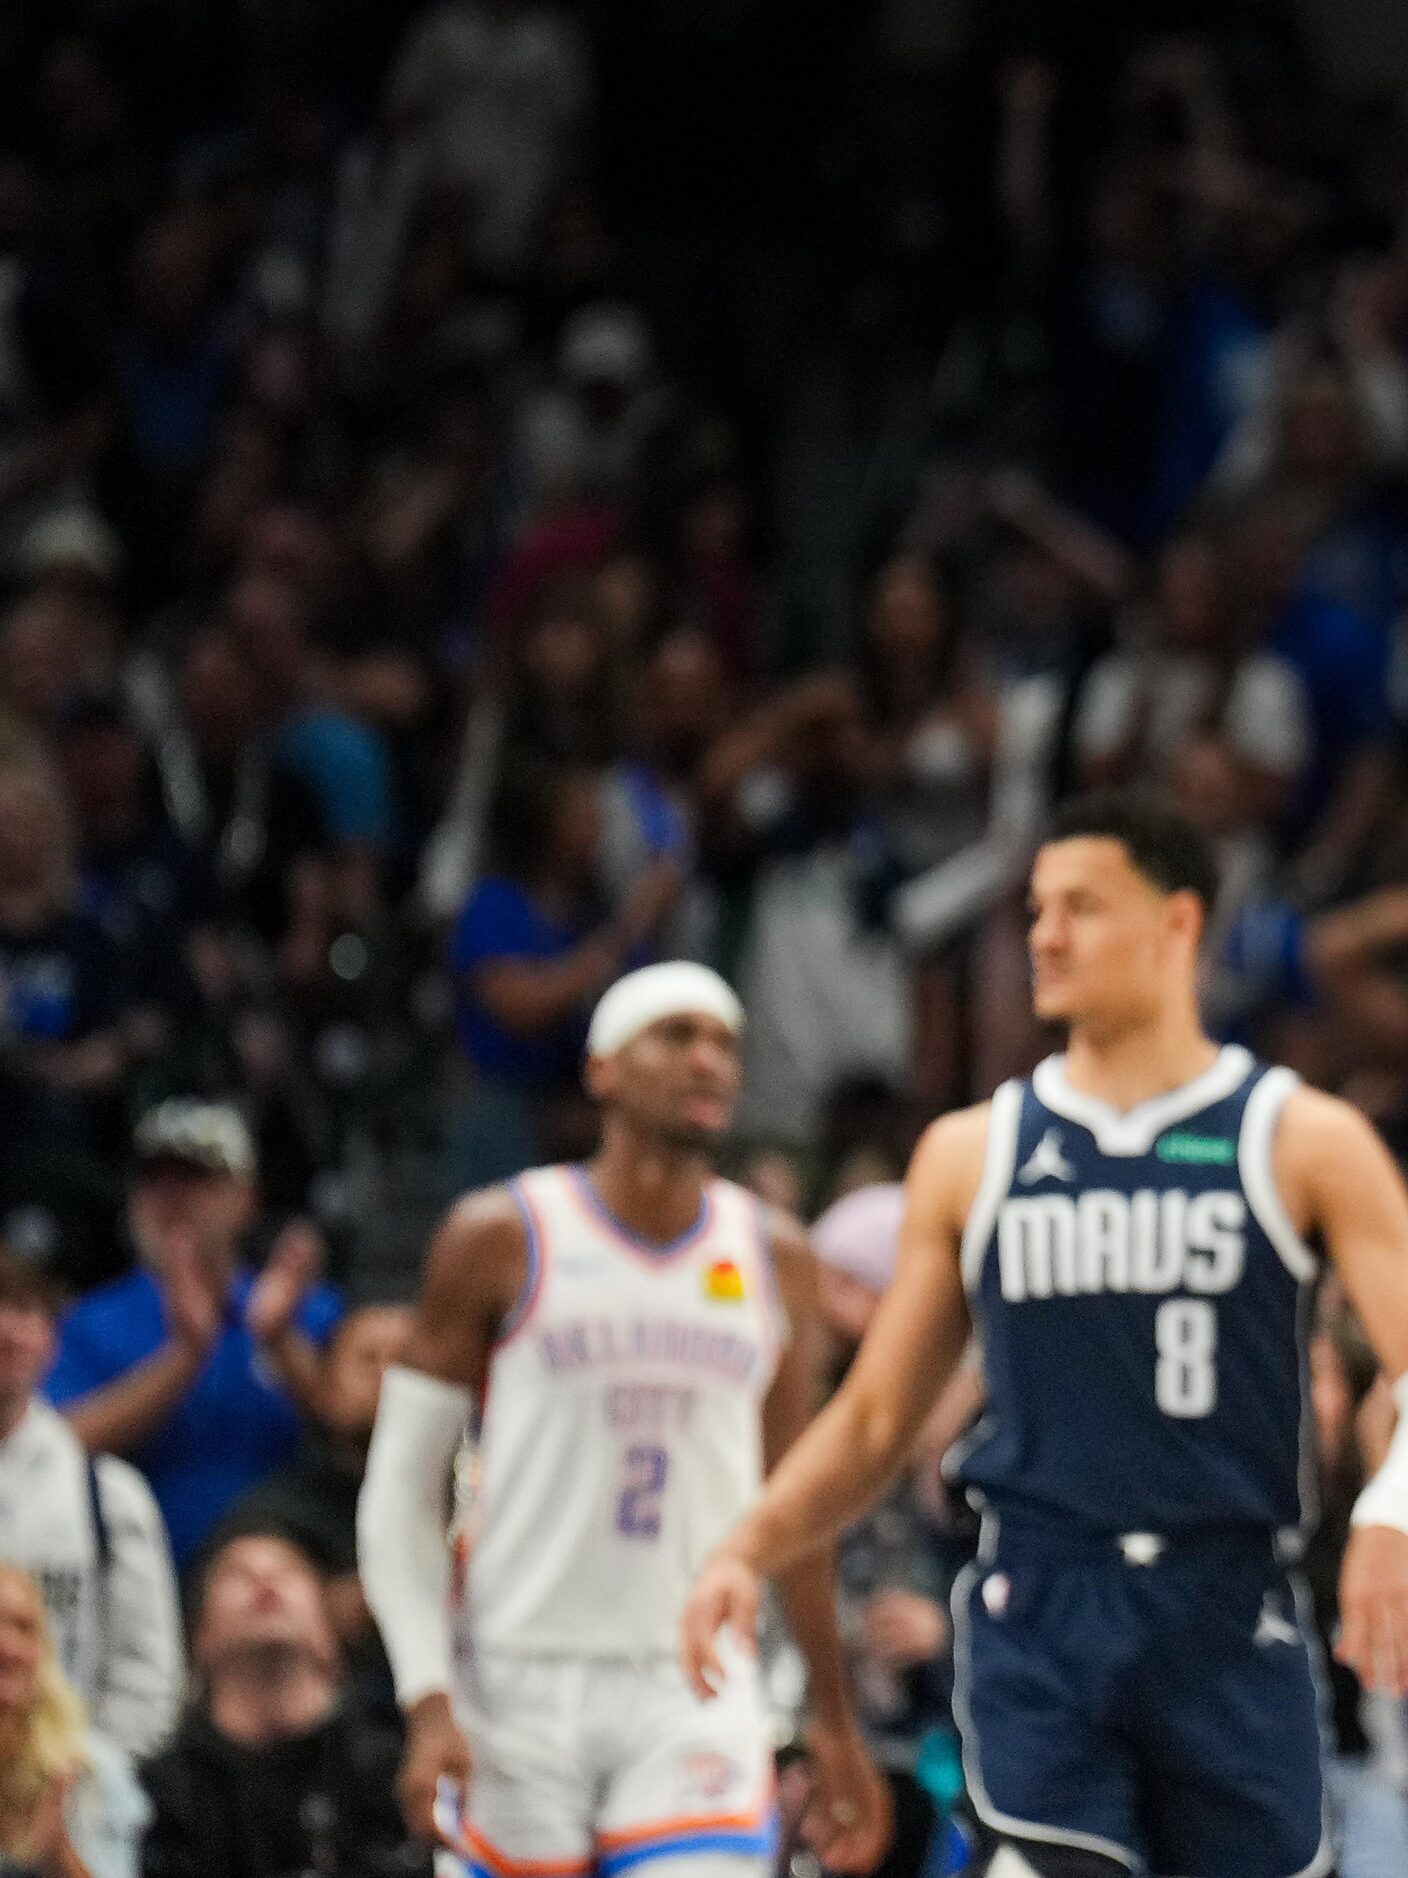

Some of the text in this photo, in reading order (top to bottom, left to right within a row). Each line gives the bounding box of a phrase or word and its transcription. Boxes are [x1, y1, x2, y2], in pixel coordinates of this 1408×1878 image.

[998, 1188, 1245, 1302] MAVS
[1155, 1299, 1217, 1419] 8
[616, 1446, 669, 1540] 2
